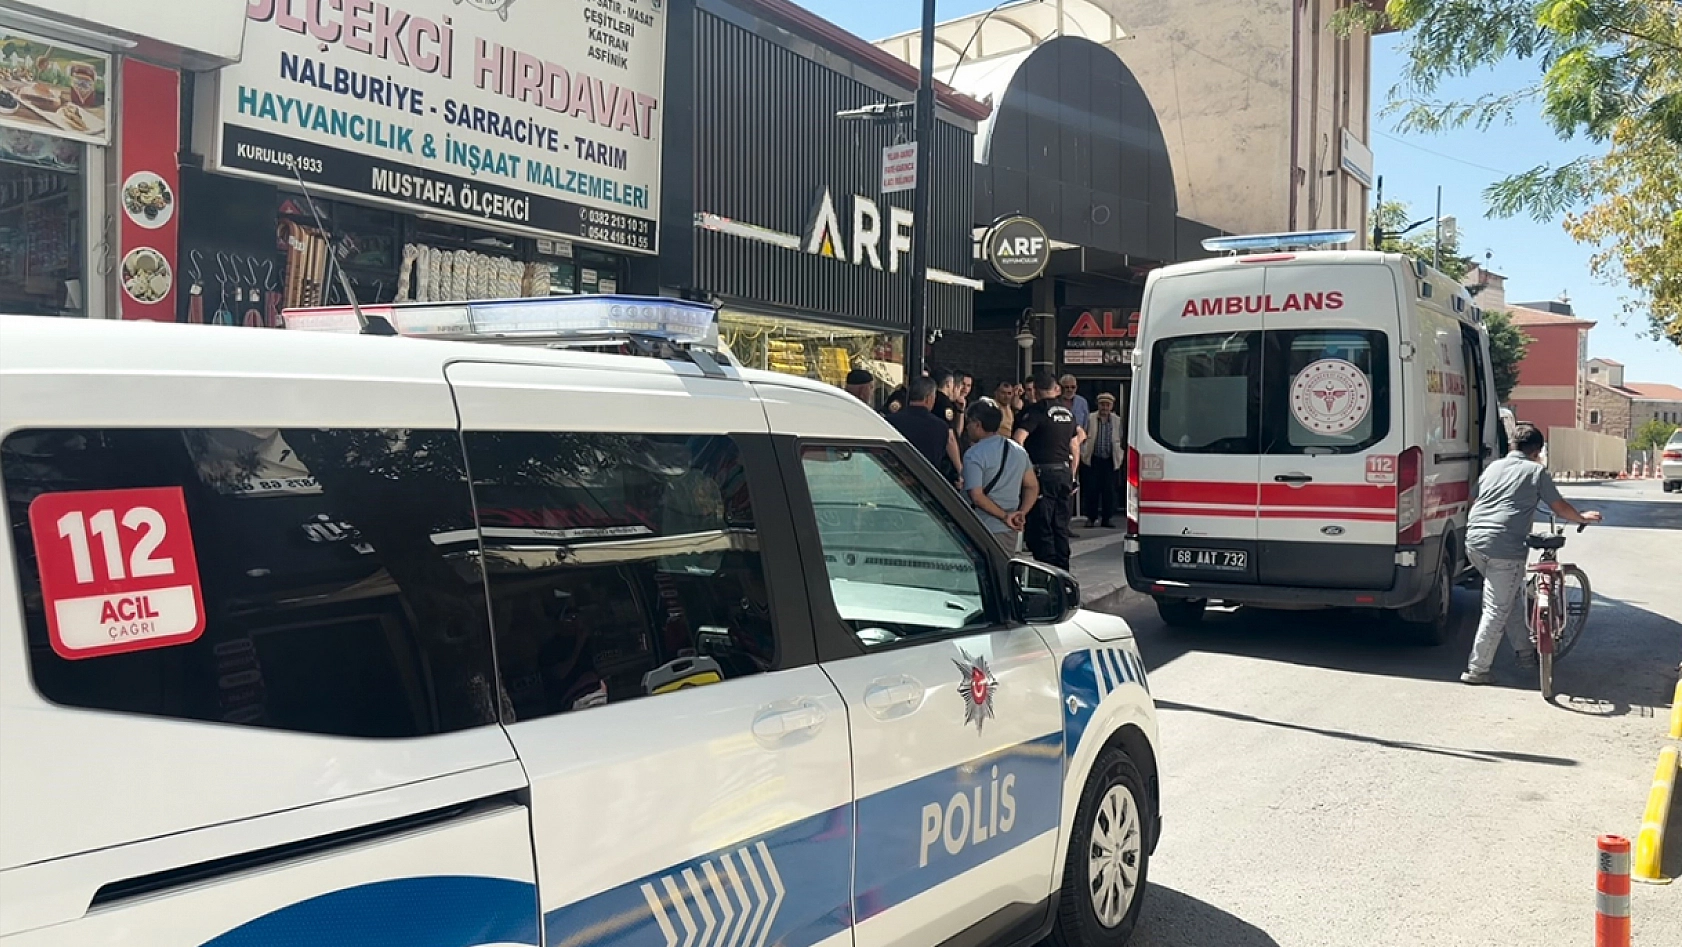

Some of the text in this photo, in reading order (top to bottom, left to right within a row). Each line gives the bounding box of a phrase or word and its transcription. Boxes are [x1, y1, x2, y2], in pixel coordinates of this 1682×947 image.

[583, 7, 635, 38] ÇEŞİTLERİ
[627, 6, 655, 28] MASAT
[588, 26, 629, 53] KATRAN
[247, 0, 657, 141] LÇEKCİ HIRDAVAT
[280, 50, 424, 116] NALBURİYE
[443, 98, 559, 153] SARRACİYE
[574, 135, 628, 171] TARIM
[237, 85, 649, 210] HAYVANCILIK & İNŞAAT MALZEMELERİ
[371, 166, 530, 222] MUSTAFA ÖLÇEKCİ
[589, 209, 648, 234] 0382 213 10 31
[807, 185, 914, 273] ARF
[627, 233, 637, 247] 13
[638, 235, 648, 249] 55
[996, 236, 1044, 256] ARF
[1181, 290, 1344, 317] AMBULANS
[1441, 400, 1457, 440] 112
[1144, 456, 1161, 469] 112
[1369, 457, 1393, 472] 112
[56, 506, 175, 584] 112
[1177, 550, 1191, 563] 68
[1197, 551, 1218, 565] AAT
[1224, 552, 1244, 567] 732
[100, 595, 159, 625] ACİL
[108, 622, 156, 641] ÇAĞRI
[919, 764, 1017, 868] POLİS
